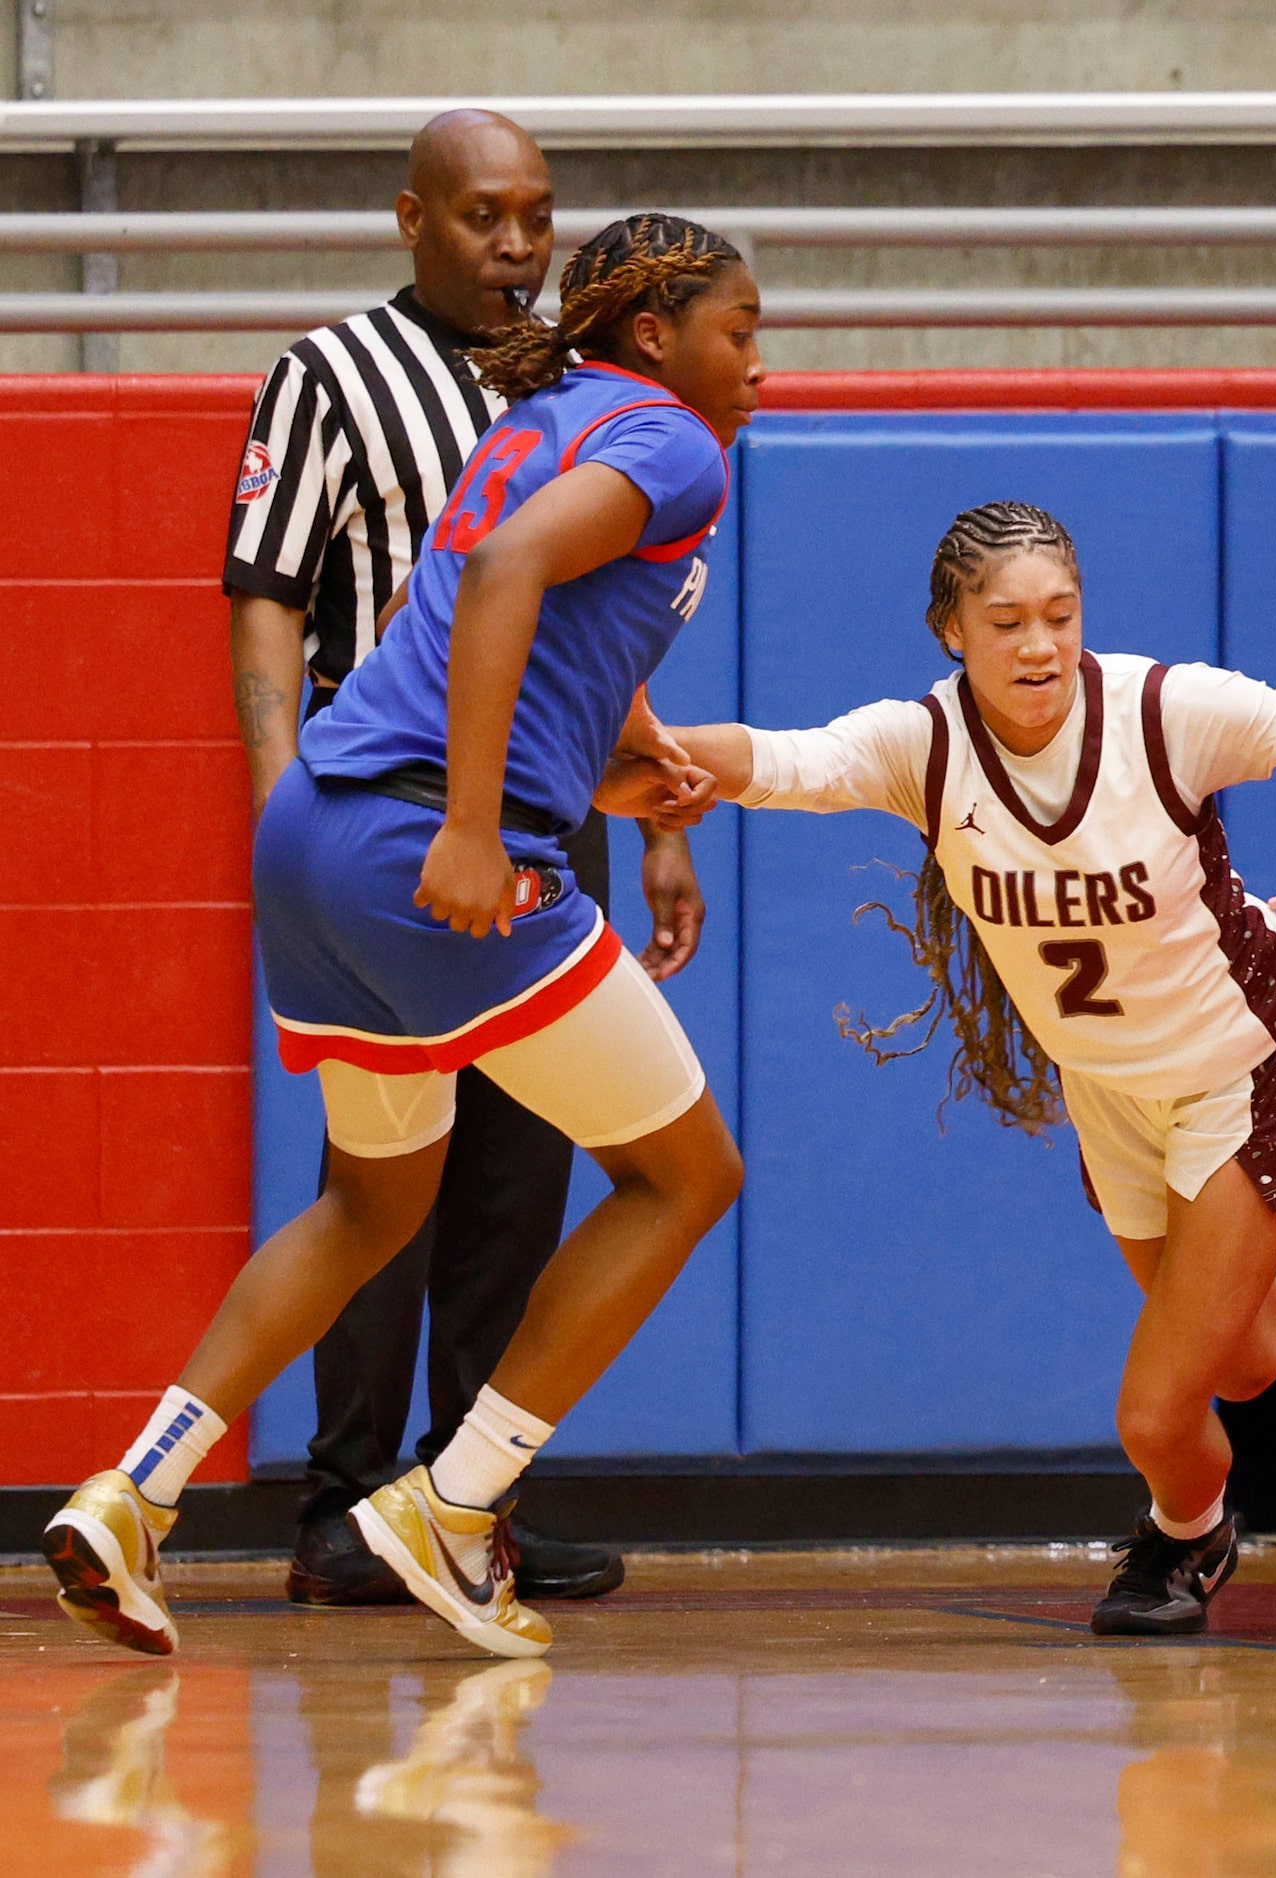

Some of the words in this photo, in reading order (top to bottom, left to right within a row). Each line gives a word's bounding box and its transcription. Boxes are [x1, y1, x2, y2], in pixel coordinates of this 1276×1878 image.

[432, 426, 543, 554] 13
[972, 861, 1156, 927] OILERS
[1038, 938, 1125, 1019] 2
